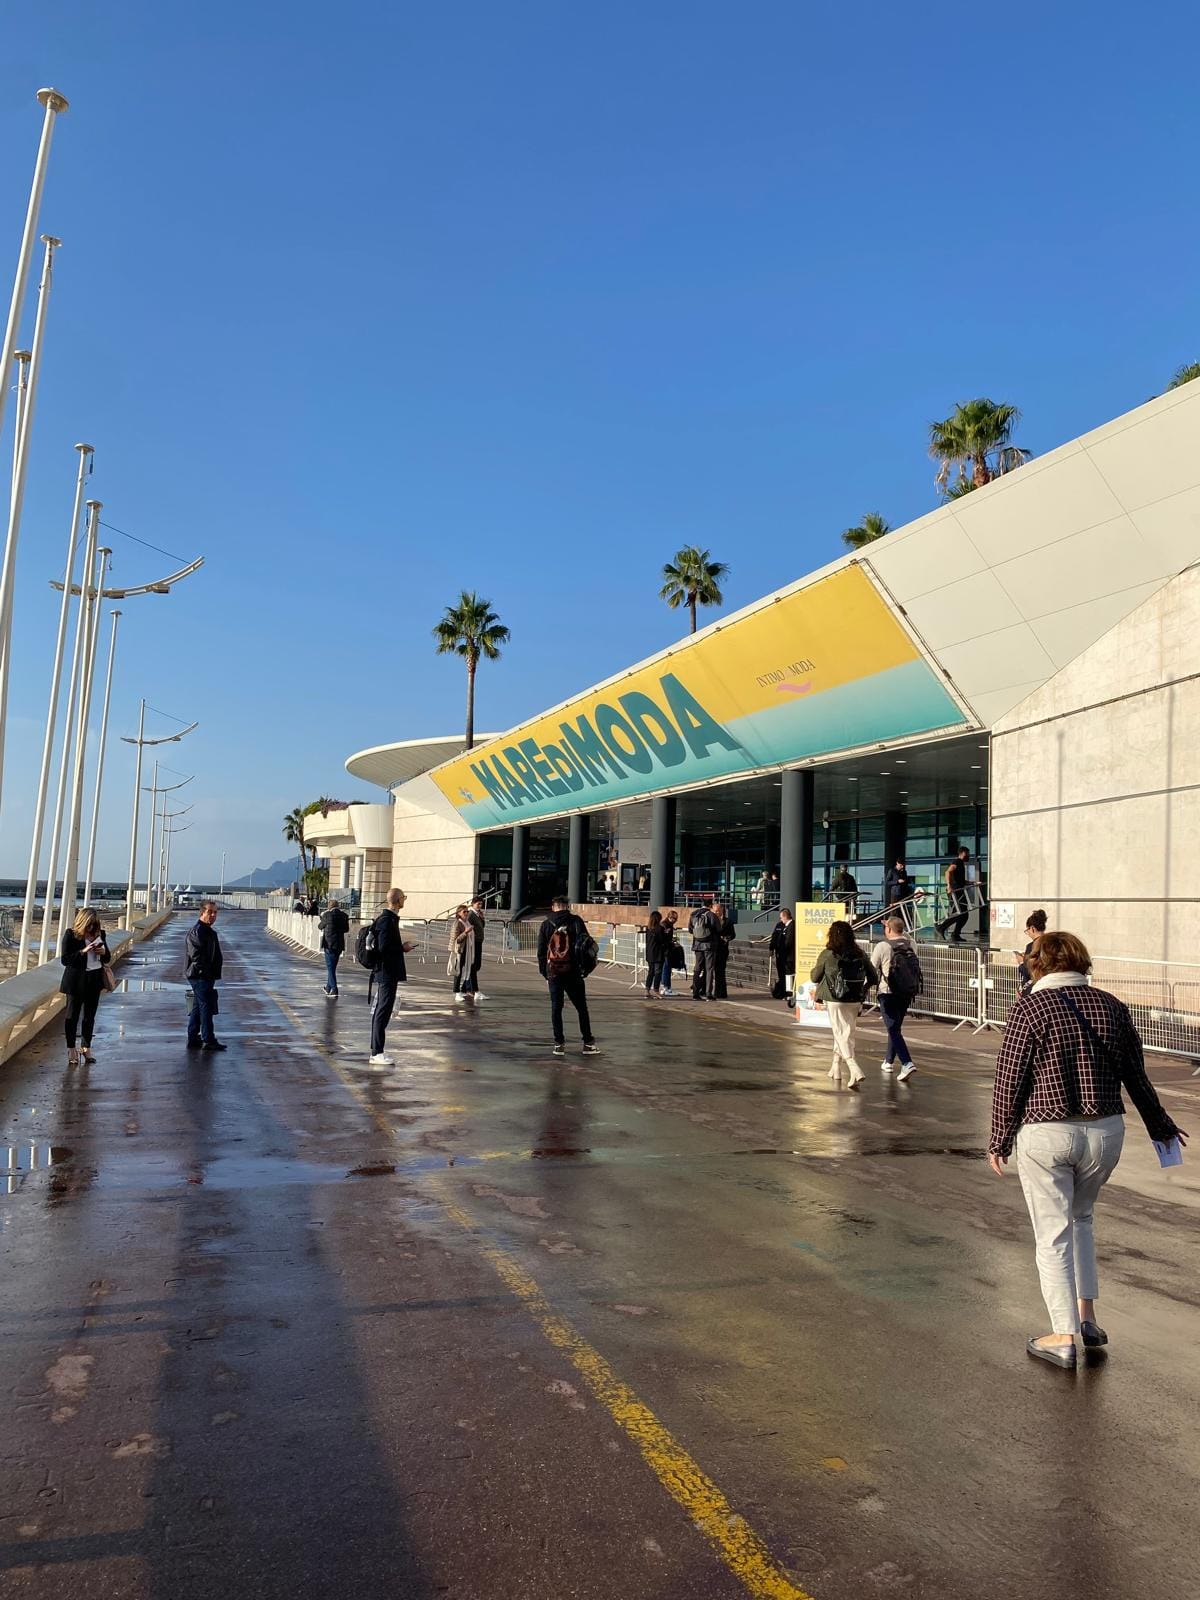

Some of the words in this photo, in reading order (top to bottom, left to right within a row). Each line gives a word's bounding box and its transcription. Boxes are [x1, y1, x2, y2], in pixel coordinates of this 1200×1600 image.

[756, 669, 786, 688] INTIMO
[787, 658, 816, 677] MODA
[804, 908, 836, 918] MARE
